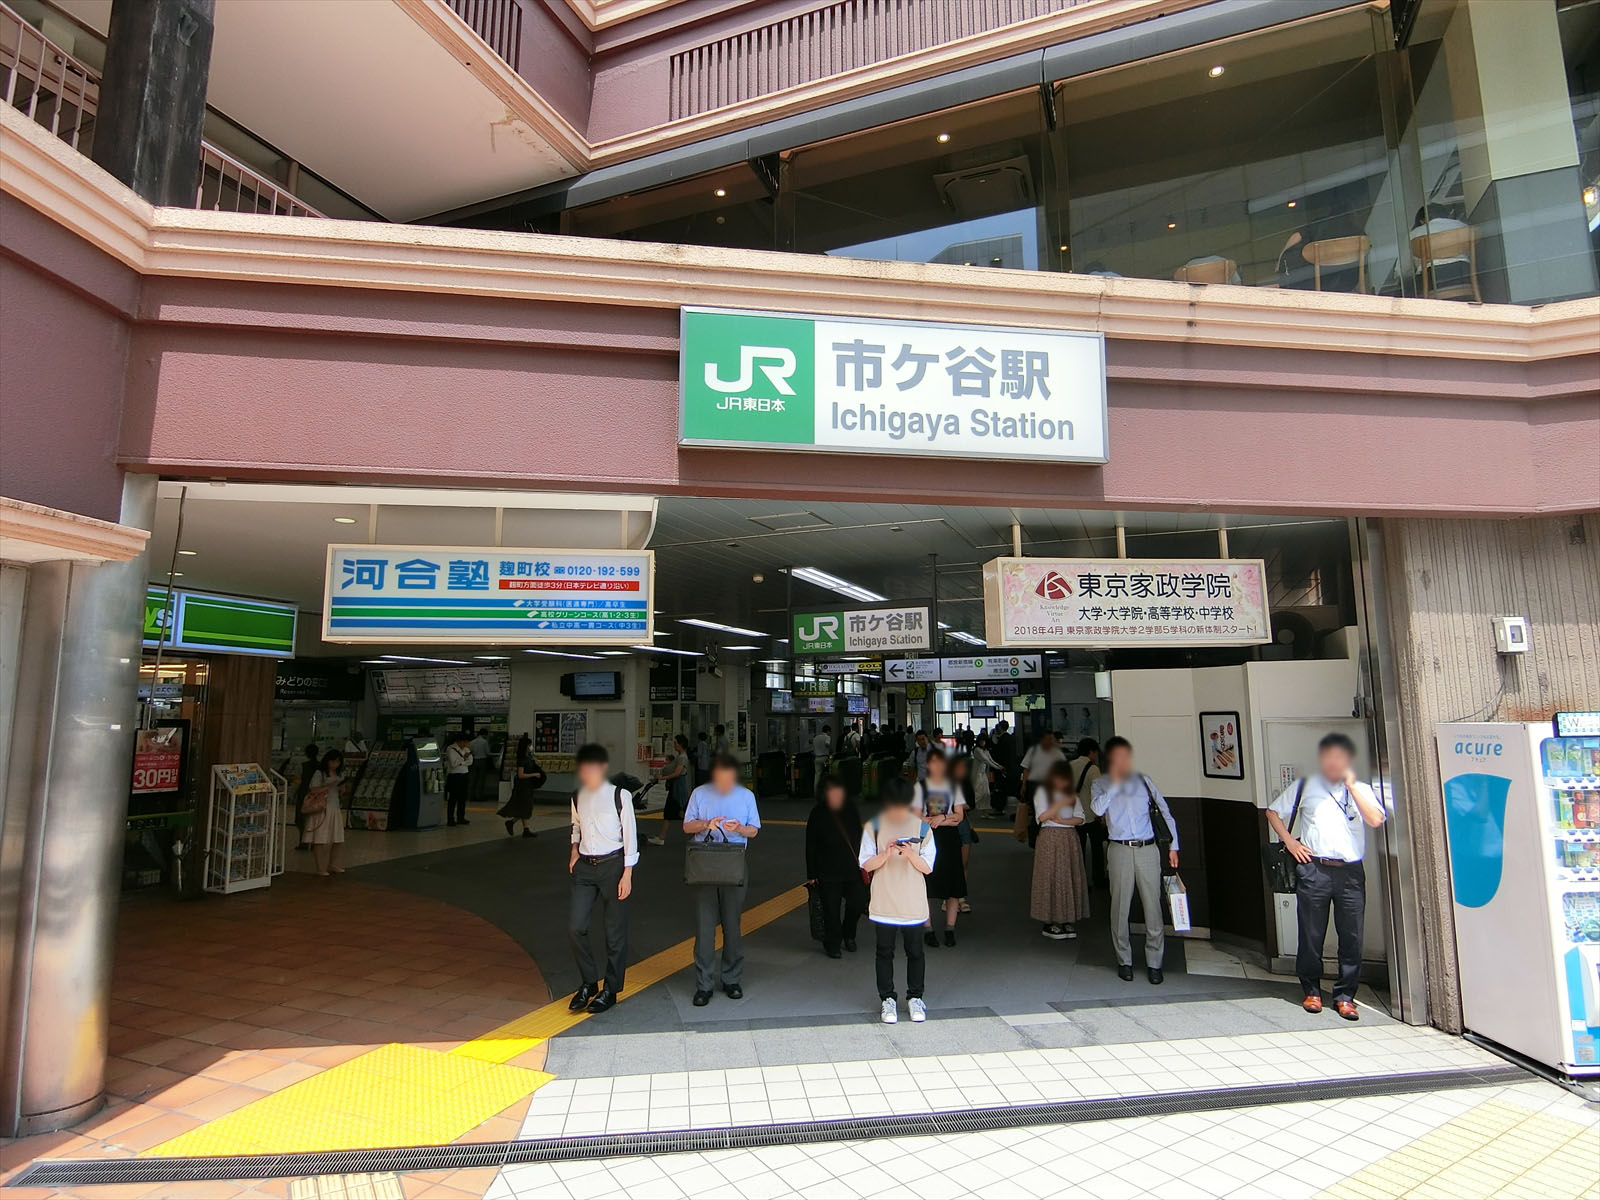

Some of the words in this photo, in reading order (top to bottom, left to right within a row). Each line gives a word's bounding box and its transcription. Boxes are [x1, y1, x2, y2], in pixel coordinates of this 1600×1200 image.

[703, 344, 798, 396] JR
[831, 338, 1052, 402] 市ケ谷駅
[716, 396, 786, 413] JR東日本
[832, 401, 960, 442] Ichigaya
[970, 407, 1075, 441] Station
[341, 558, 490, 591] 河合塾
[567, 564, 640, 578] 0120-192-599
[1077, 572, 1232, 600] 東京家政学院
[798, 615, 839, 641] JR
[849, 611, 923, 633] 市ケ谷駅
[1014, 625, 1064, 636] 2018年4月
[849, 635, 888, 649] Ichigaya
[889, 634, 923, 645] Station
[1454, 741, 1504, 757] acure
